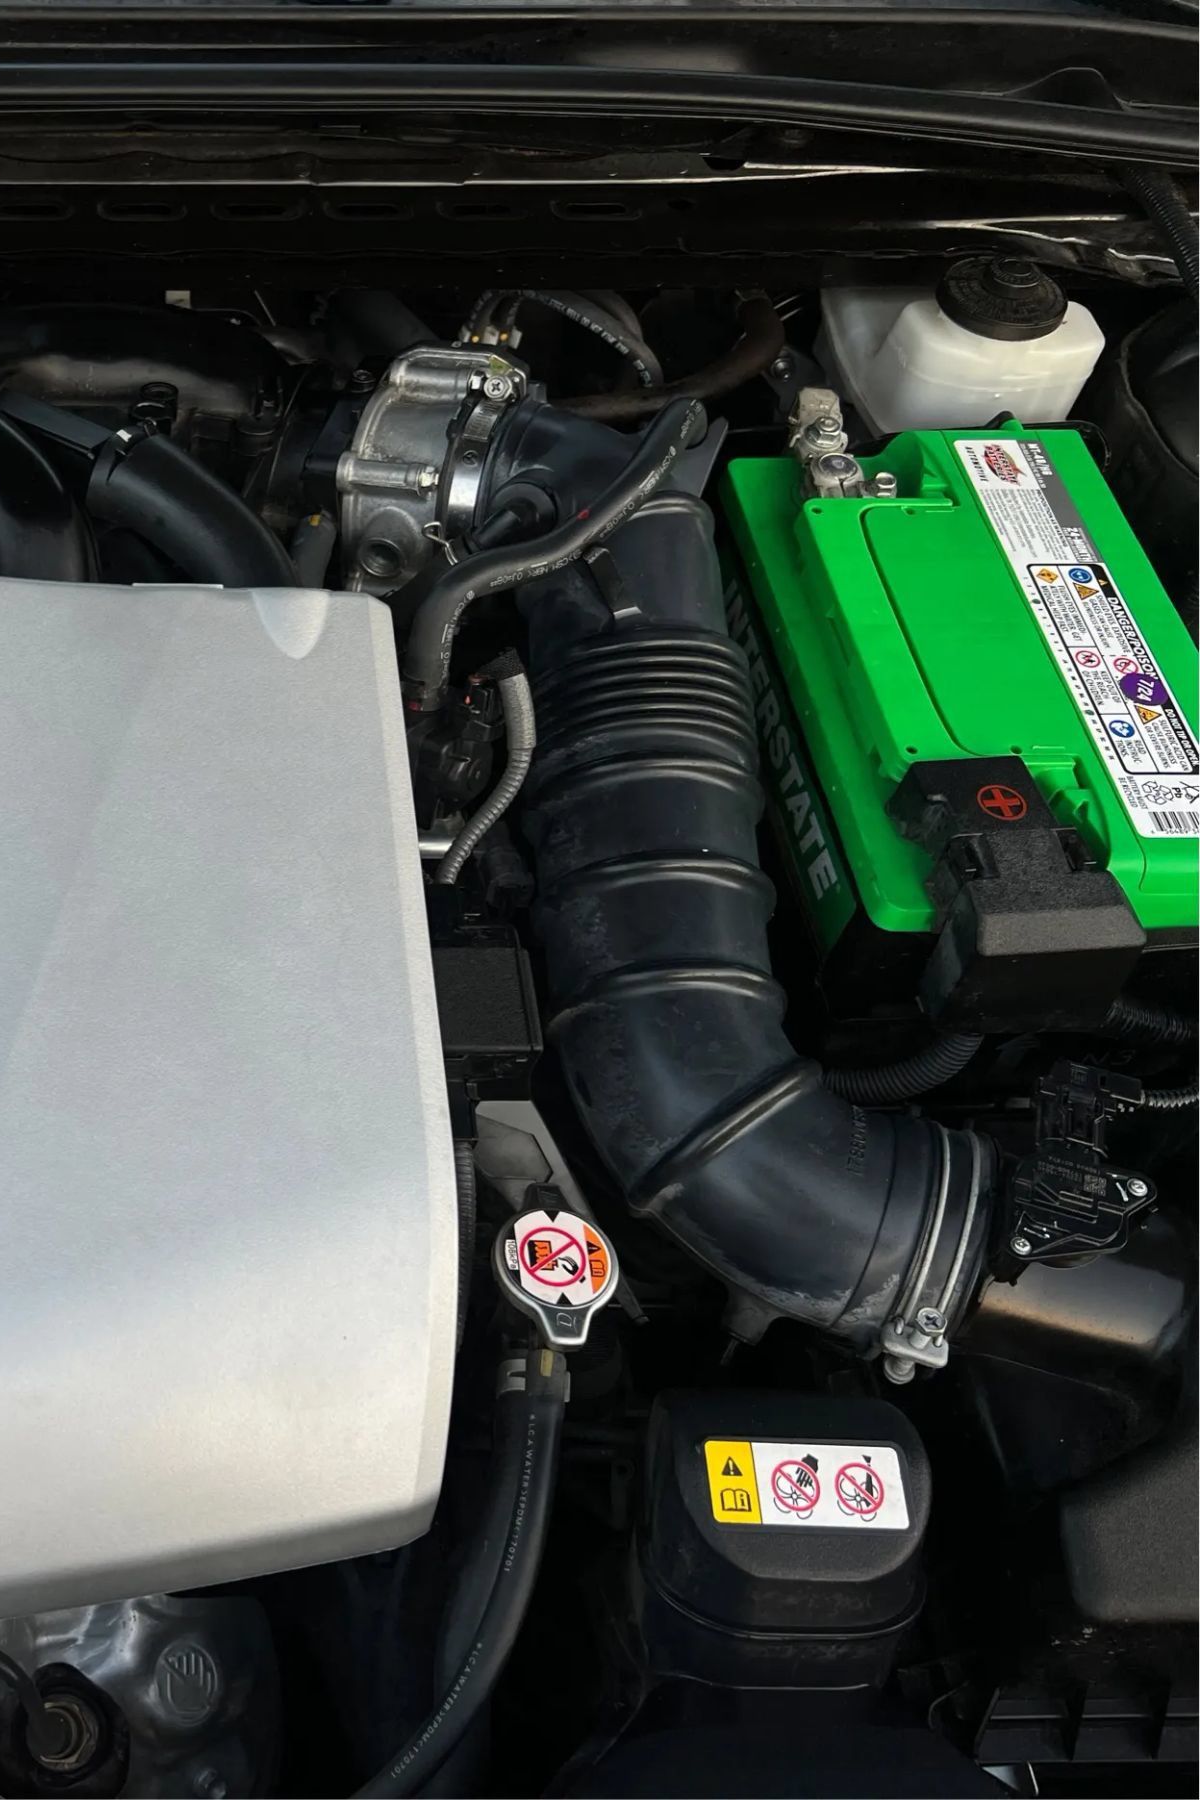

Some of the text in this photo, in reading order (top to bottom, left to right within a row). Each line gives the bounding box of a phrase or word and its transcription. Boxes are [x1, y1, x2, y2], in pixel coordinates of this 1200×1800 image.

[963, 446, 989, 482] AUTOMOTIVE
[984, 446, 1008, 481] BATTERIES
[991, 444, 1019, 485] INTERSTATE
[1039, 585, 1056, 606] MEDICAL
[1050, 607, 1062, 620] HELP
[1056, 585, 1070, 600] FLUSH
[1064, 601, 1076, 612] EYES
[1048, 585, 1060, 599] ATELY
[1055, 600, 1067, 612] WITH
[1070, 632, 1082, 641] GET
[1081, 601, 1098, 624] BLINDNESS
[1088, 599, 1114, 637] GASES CAN CAUSE
[1095, 595, 1109, 612] SHIELD
[1111, 626, 1130, 652] EXPLOSIVE
[1090, 671, 1101, 680] THE
[1099, 670, 1111, 683] KEEP
[1106, 685, 1117, 695] OUT
[1095, 681, 1110, 699] REACH
[1136, 679, 1155, 702] 7/24
[1164, 708, 1175, 717] DO
[1169, 719, 1181, 729] NOT
[723, 580, 839, 900] INTERSTATE
[1133, 739, 1146, 754] READ
[1148, 734, 1162, 750] SEVERE
[1150, 722, 1177, 764] CAUSE BLINDNESS
[1158, 719, 1190, 770] SULFURIC ACID CAN
[1175, 730, 1186, 739] TIP
[1180, 740, 1191, 748] OR
[1121, 785, 1138, 807] RECYCLED
[1126, 776, 1148, 809] BATTERY MUST
[1171, 787, 1184, 798] Pb
